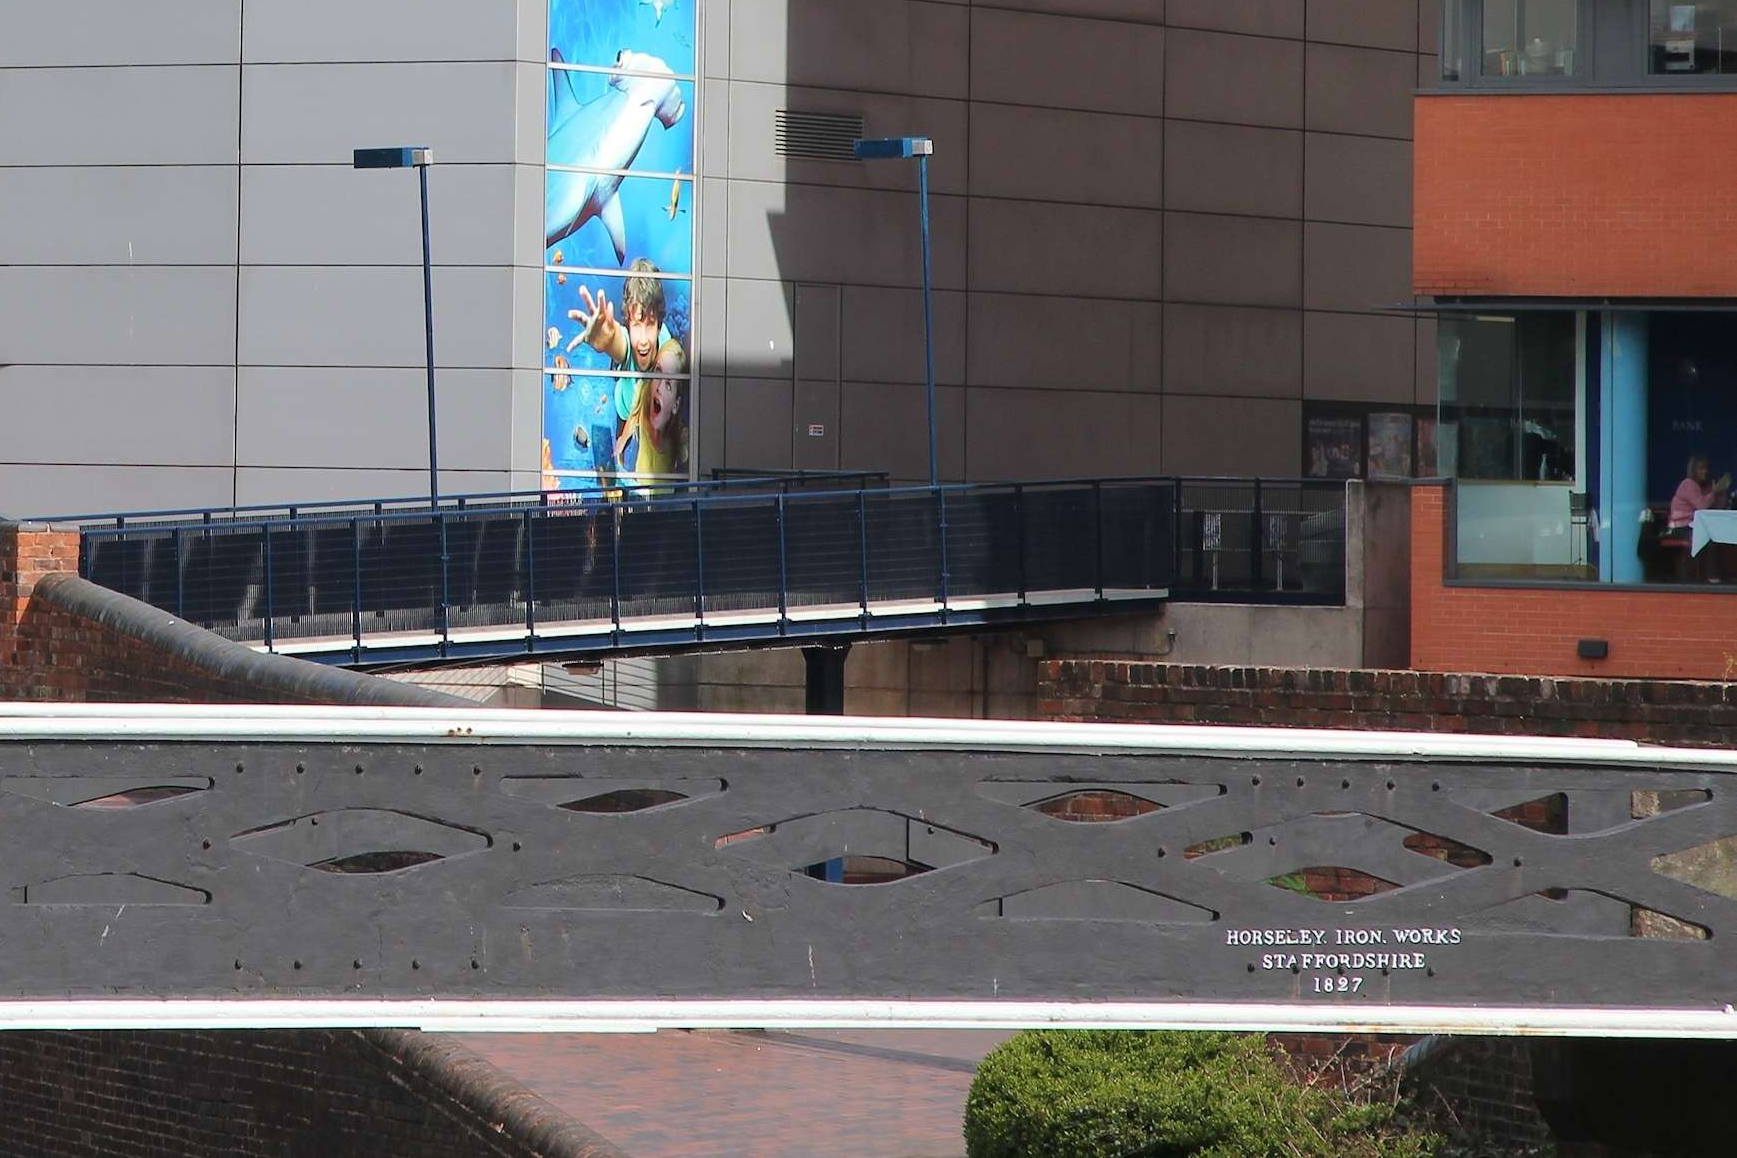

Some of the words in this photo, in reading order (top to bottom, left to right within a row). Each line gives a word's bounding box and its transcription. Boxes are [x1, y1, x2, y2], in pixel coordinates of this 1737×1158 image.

[1392, 928, 1462, 944] WORKS
[1262, 953, 1426, 969] STAFFORDSHIRE
[1314, 977, 1363, 992] 1827
